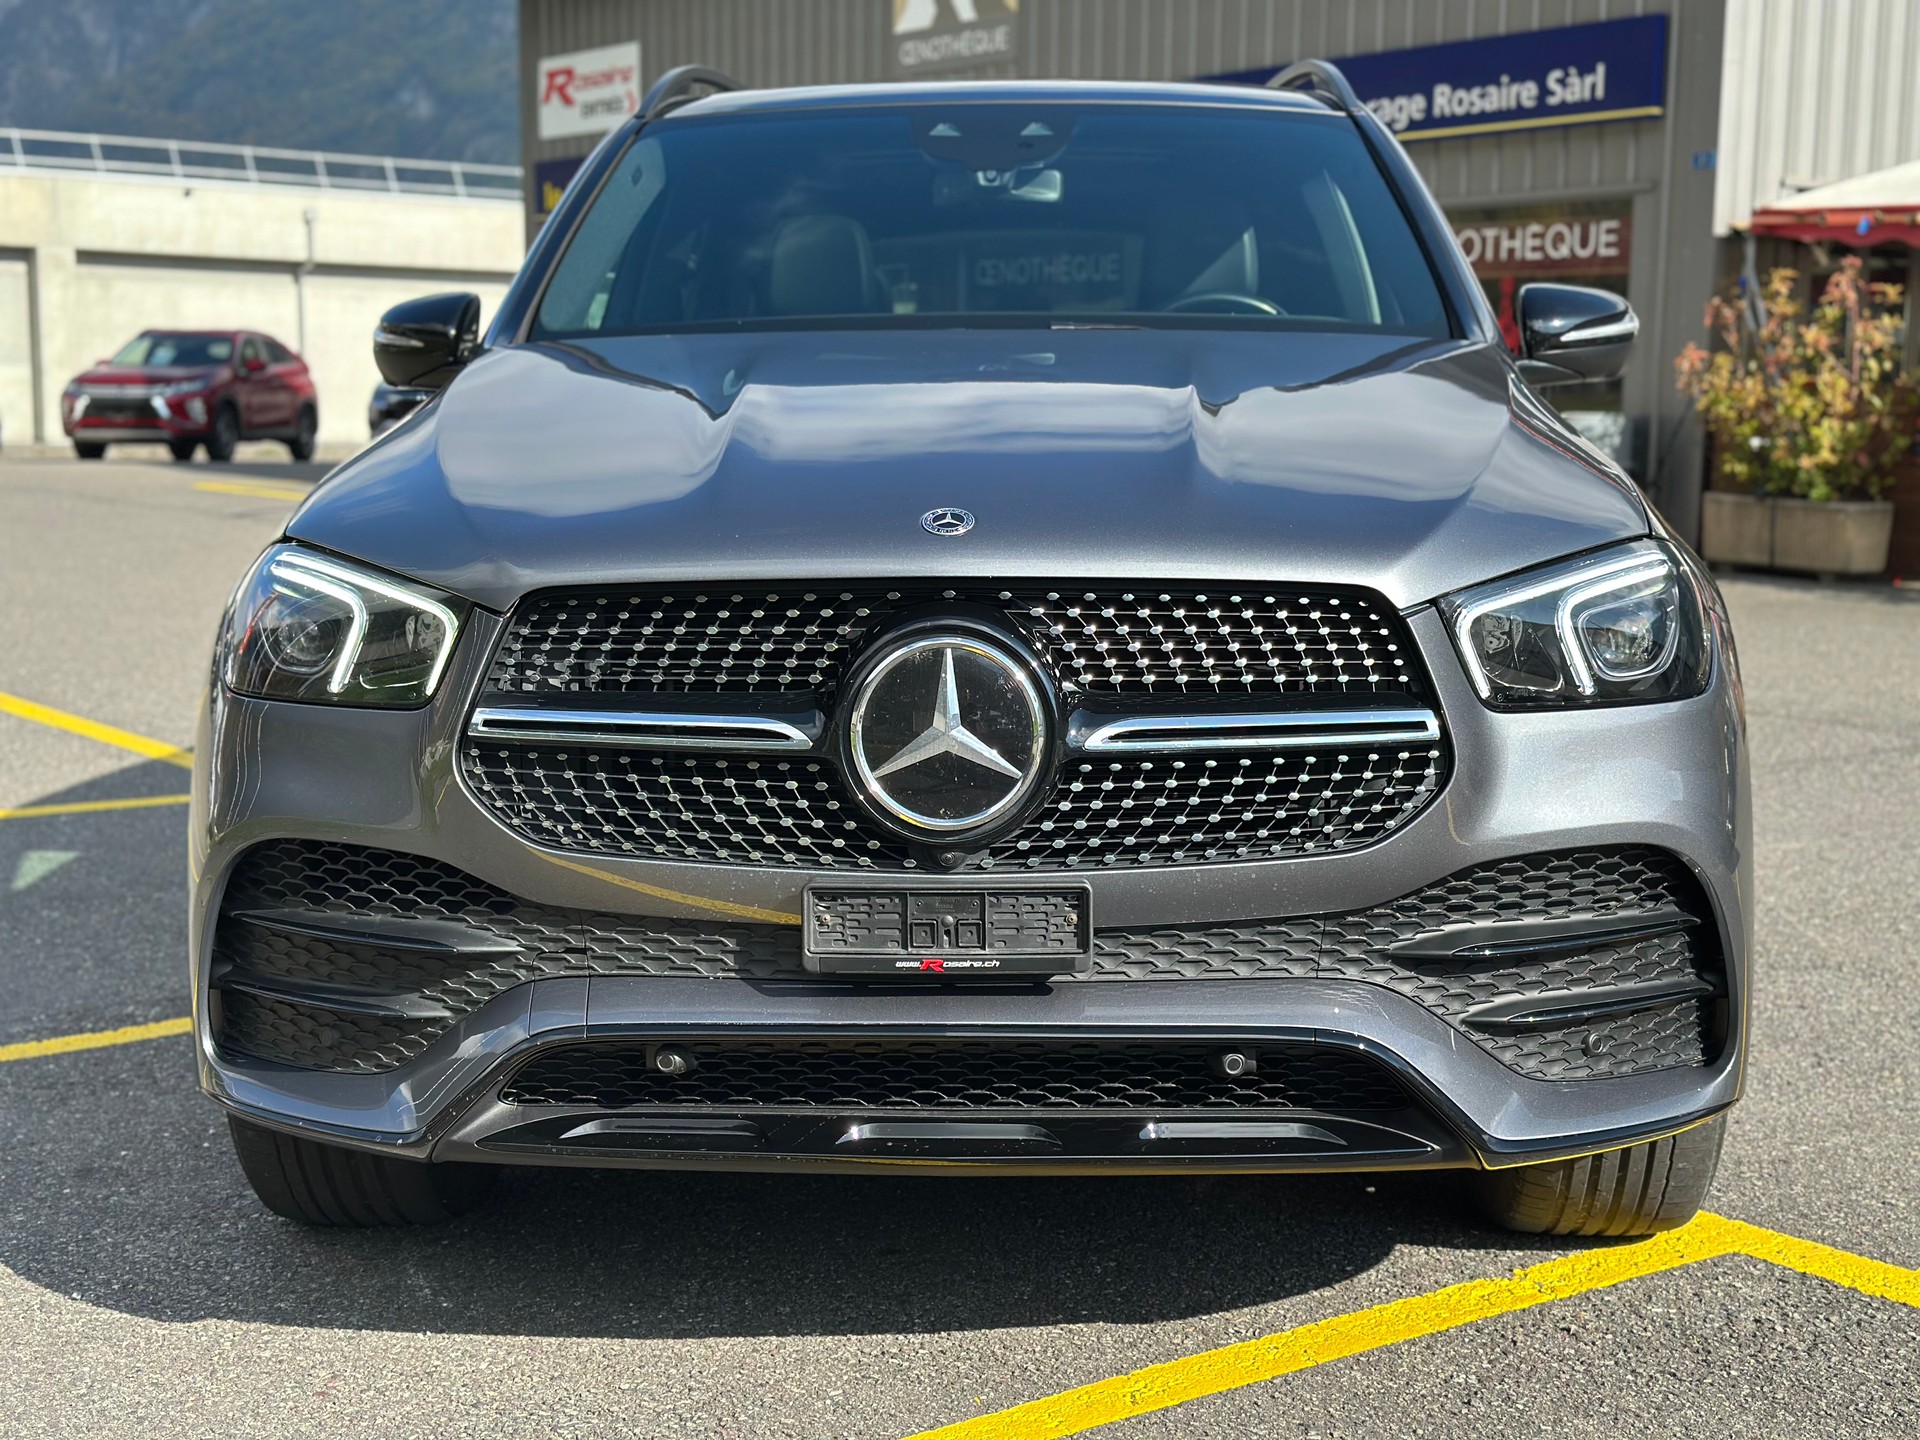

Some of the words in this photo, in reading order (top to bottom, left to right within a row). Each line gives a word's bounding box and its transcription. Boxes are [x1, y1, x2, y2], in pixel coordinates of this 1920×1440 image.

[1433, 73, 1539, 118] Rosaire
[1545, 61, 1606, 106] Sàrl
[895, 958, 1000, 972] www.Rosaire.ch
